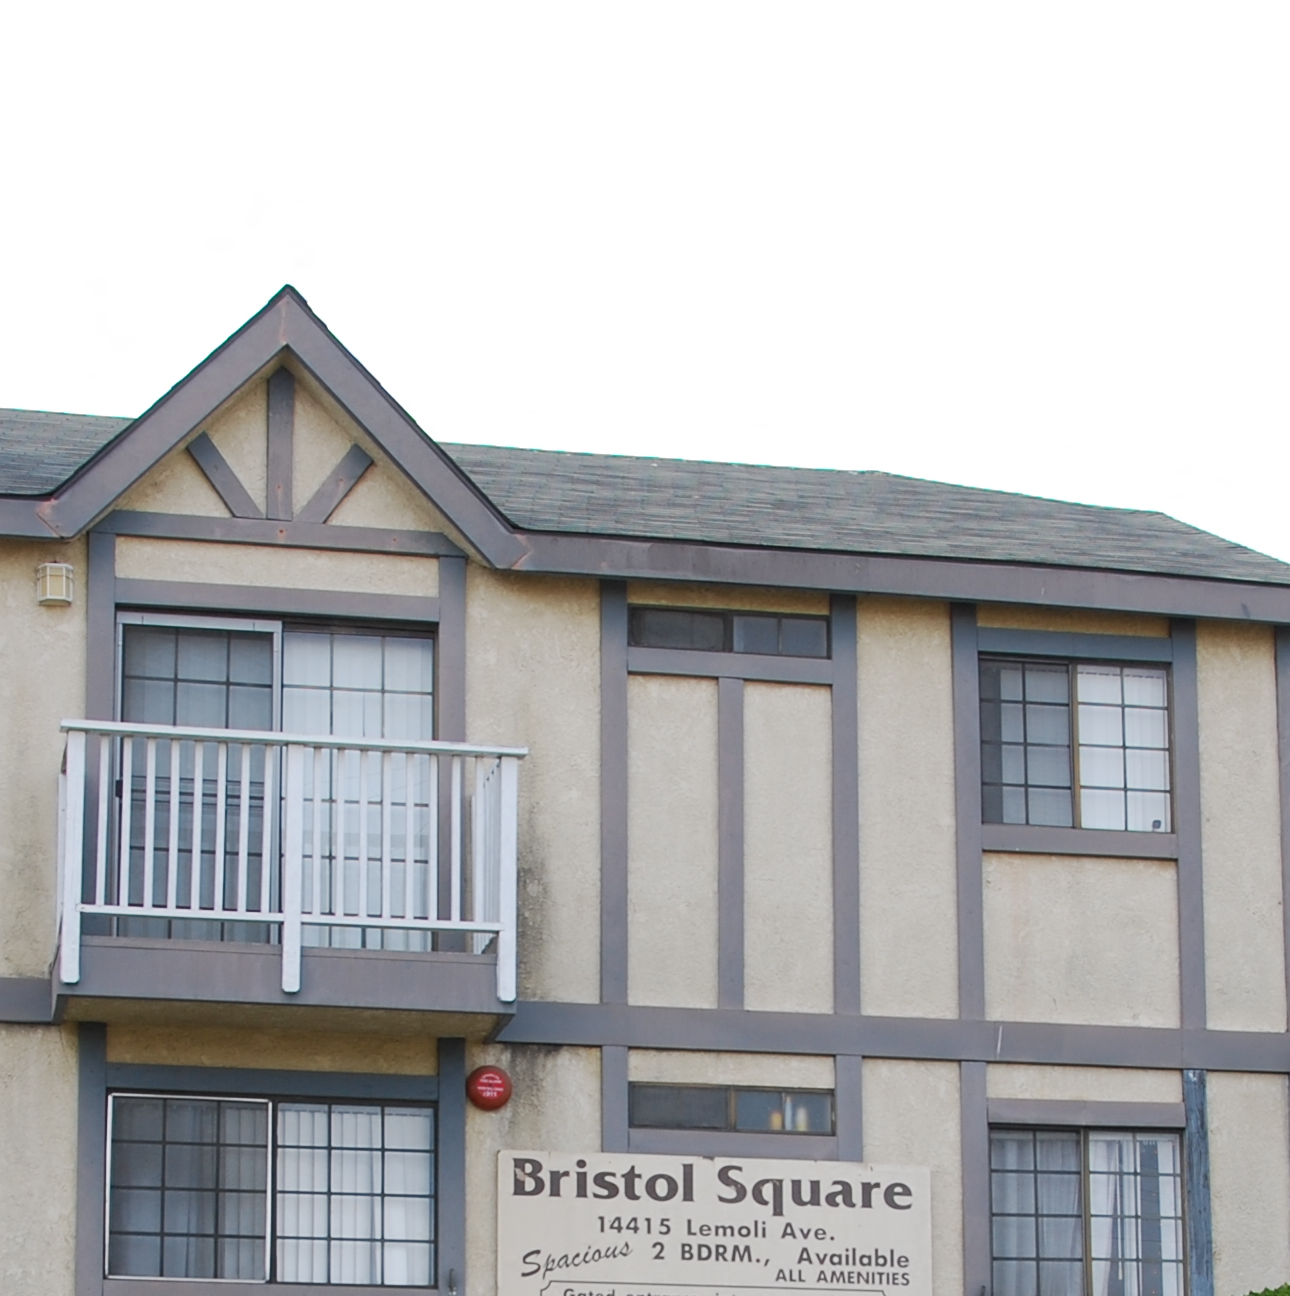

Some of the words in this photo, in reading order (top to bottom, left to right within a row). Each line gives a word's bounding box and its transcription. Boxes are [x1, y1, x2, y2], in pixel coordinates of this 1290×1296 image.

[512, 1157, 695, 1202] Bristol
[717, 1165, 913, 1217] Square
[598, 1216, 671, 1236] 14415
[687, 1218, 767, 1239] Lemoli
[781, 1222, 835, 1241] Ave.
[521, 1241, 633, 1280] Spacious
[652, 1242, 665, 1261] 2
[681, 1243, 771, 1267] BDRM.,
[797, 1247, 910, 1269] Available
[775, 1269, 806, 1283] ALL
[816, 1270, 910, 1287] AMENITIES
